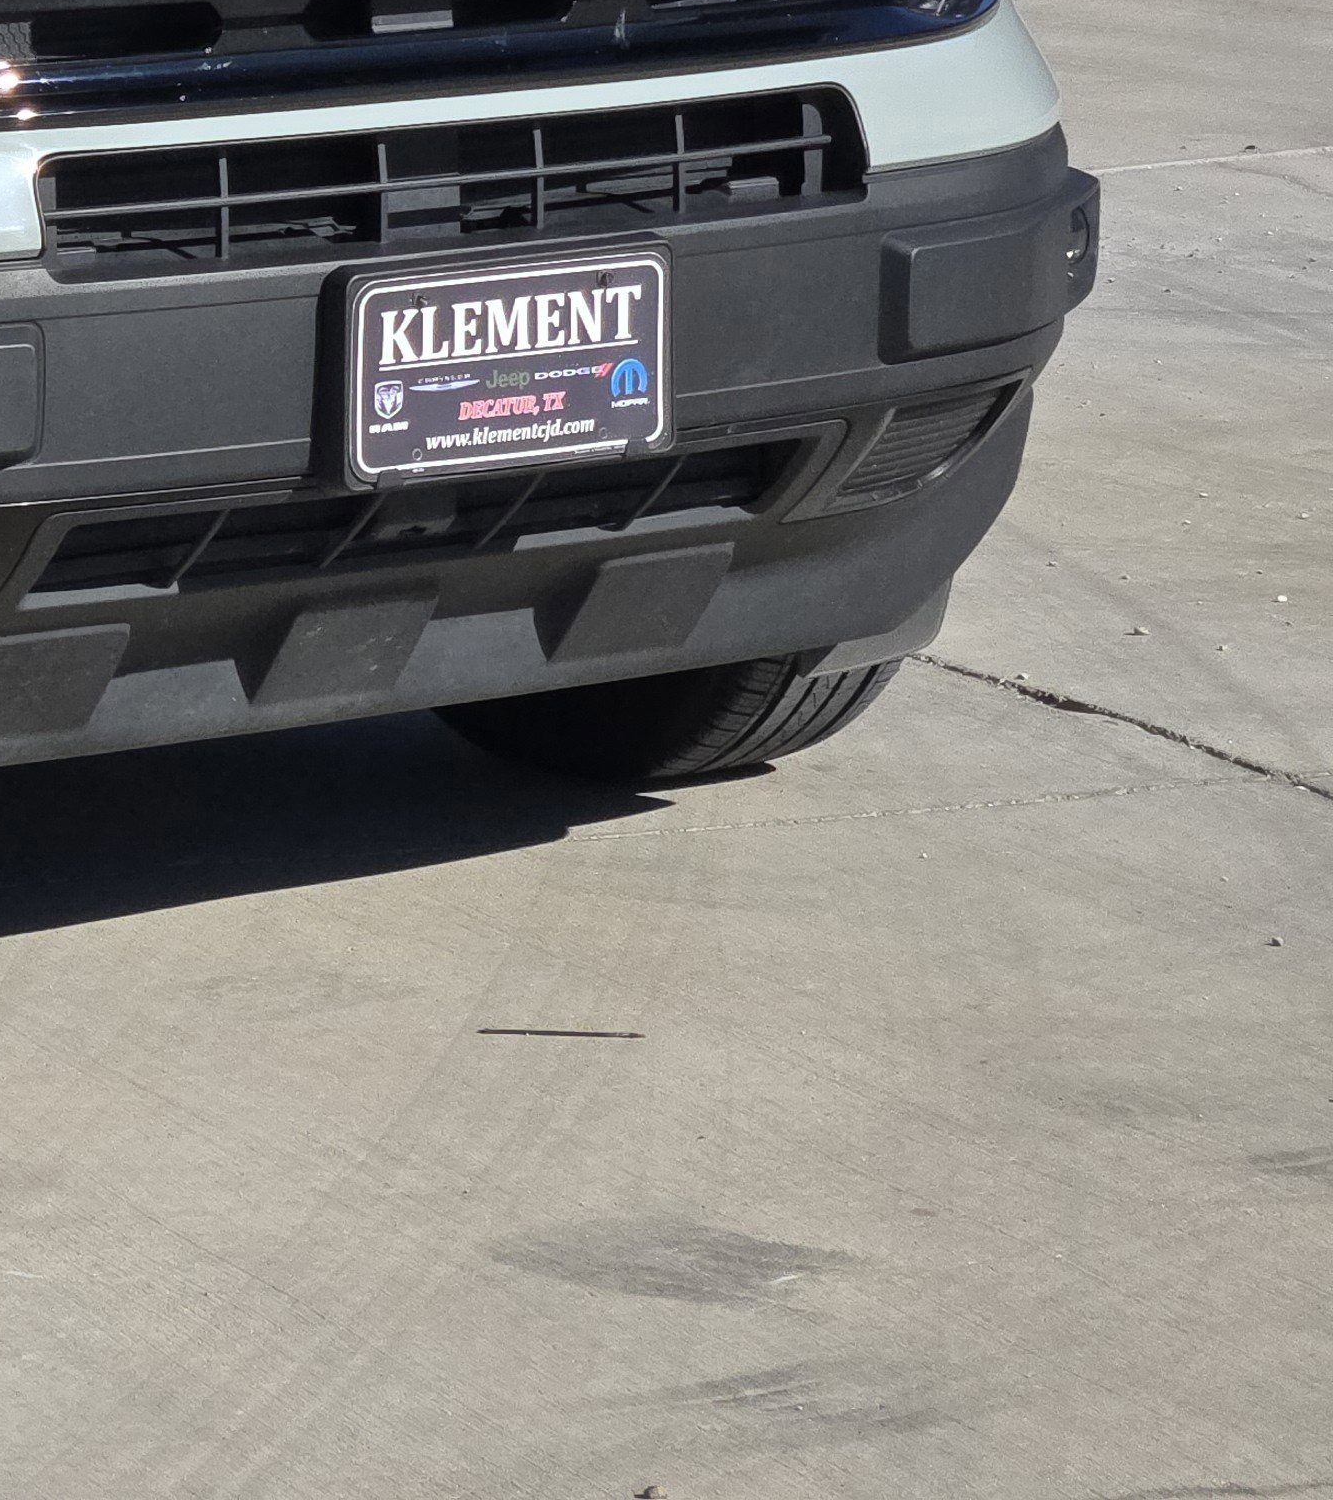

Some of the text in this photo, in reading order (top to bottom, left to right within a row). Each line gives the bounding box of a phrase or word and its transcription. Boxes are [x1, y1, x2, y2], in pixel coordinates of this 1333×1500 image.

[378, 284, 643, 366] KLEMENT
[486, 368, 531, 391] Jeep
[534, 366, 602, 381] DODGE
[458, 390, 567, 421] DECATUR, TX
[369, 421, 409, 434] RAM
[425, 417, 595, 451] www.klementcjd.com
